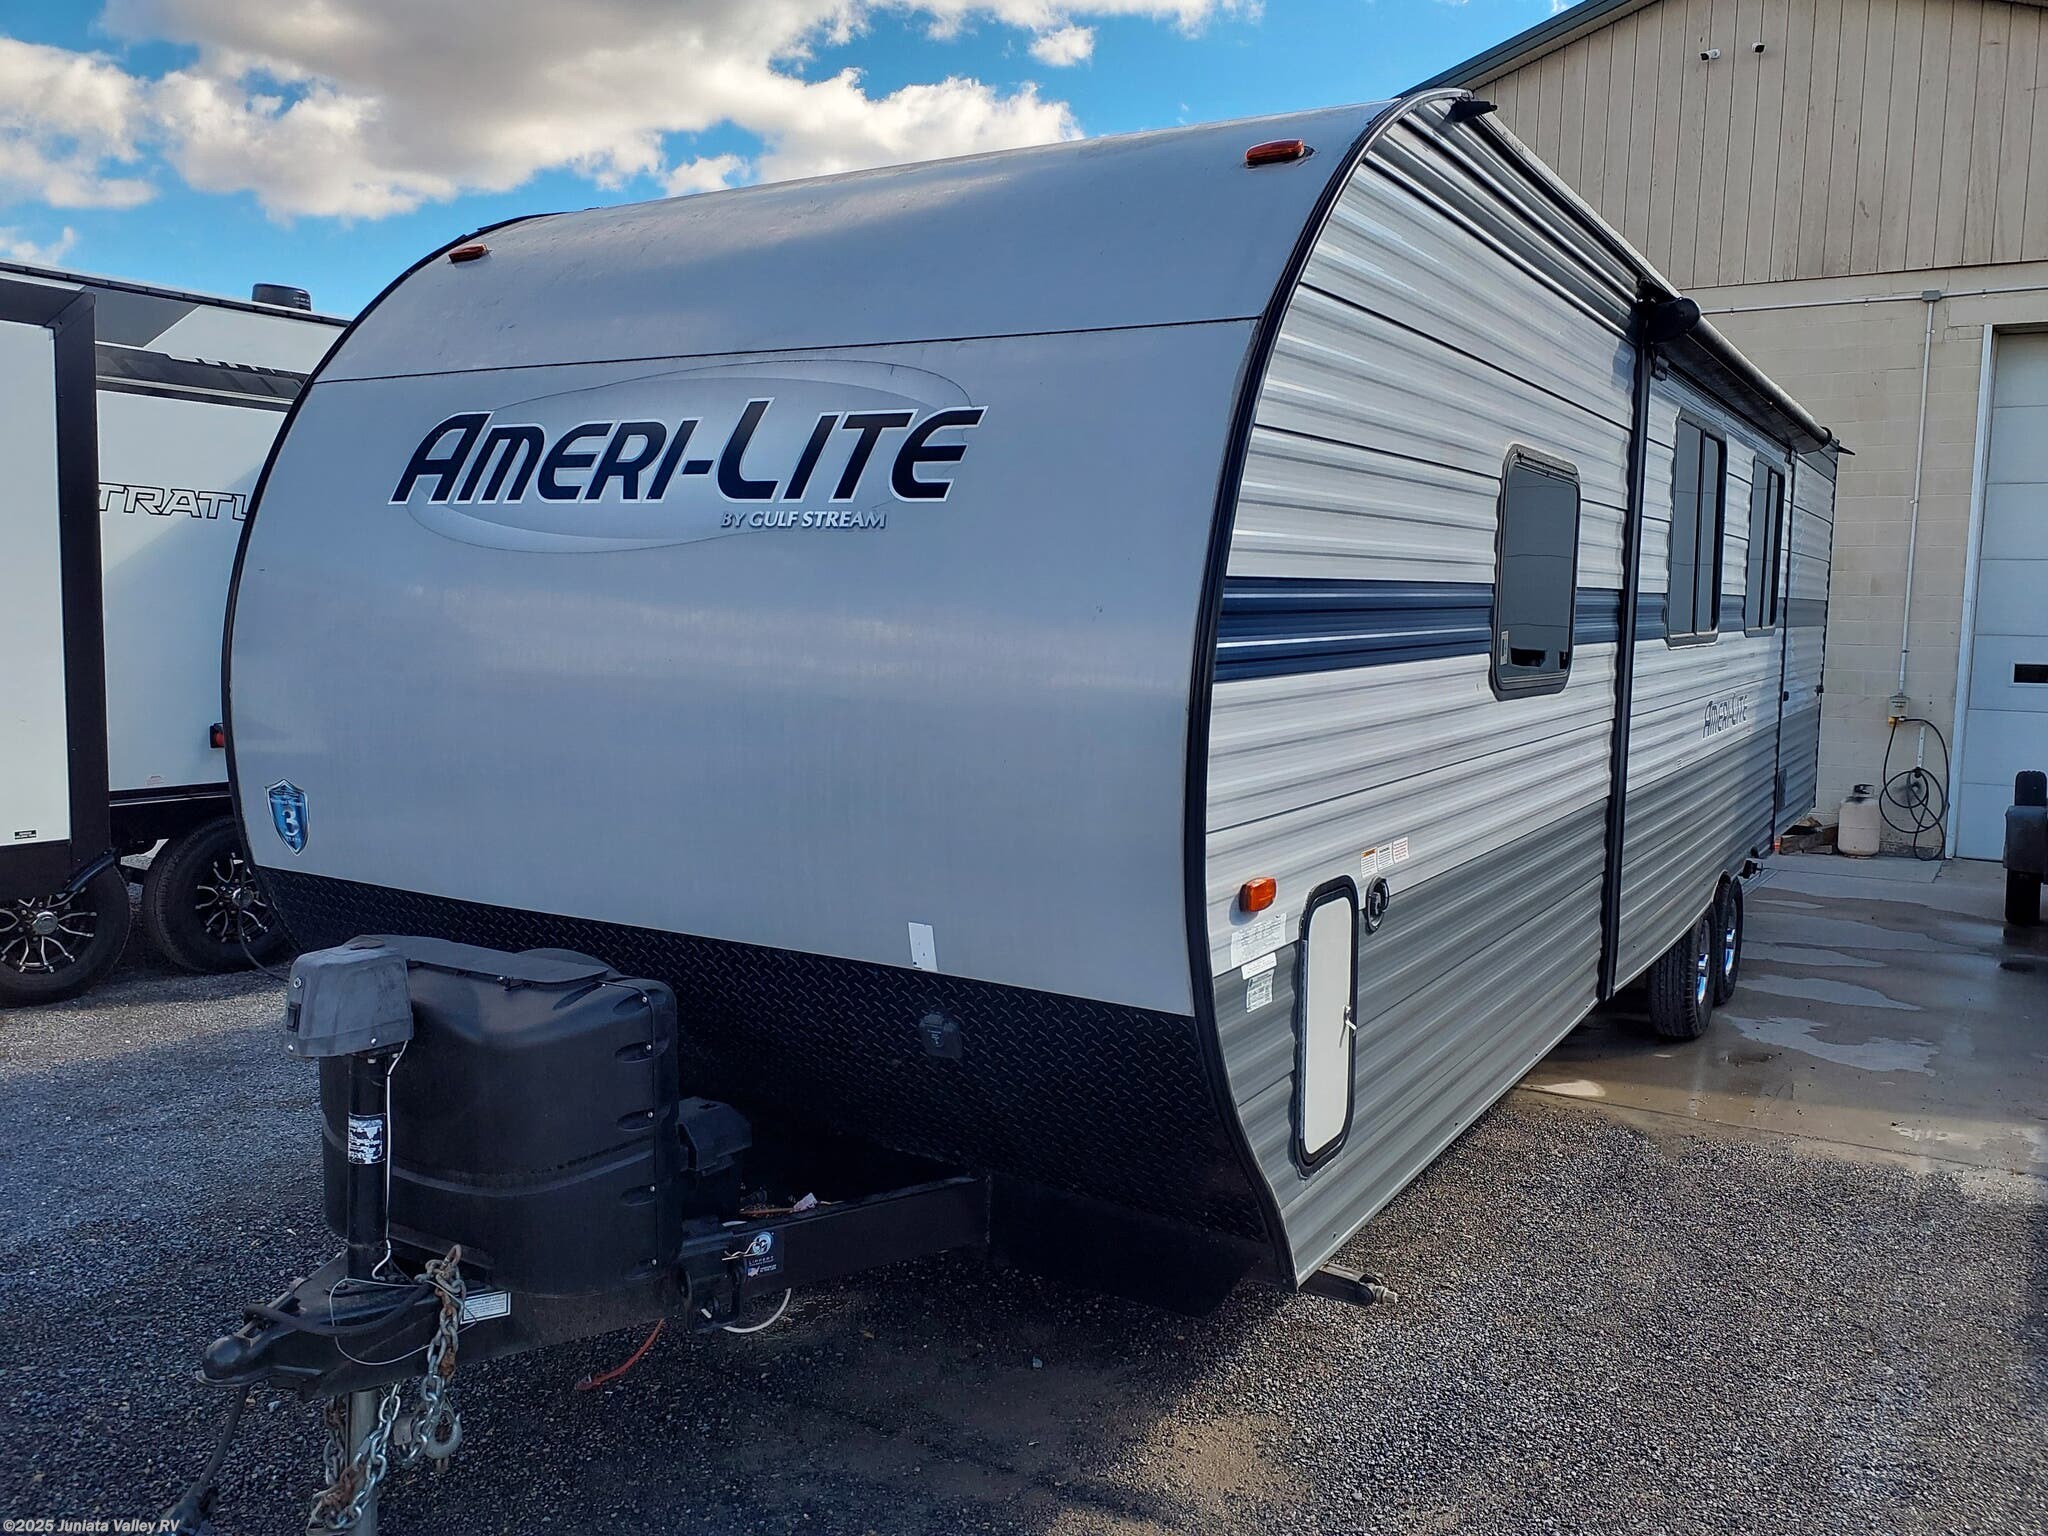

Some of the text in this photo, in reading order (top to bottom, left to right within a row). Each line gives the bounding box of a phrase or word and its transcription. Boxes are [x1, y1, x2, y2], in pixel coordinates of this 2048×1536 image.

[387, 397, 988, 506] AMERI-LITE
[721, 510, 887, 529] BY GULF STREAM
[282, 809, 300, 836] 3
